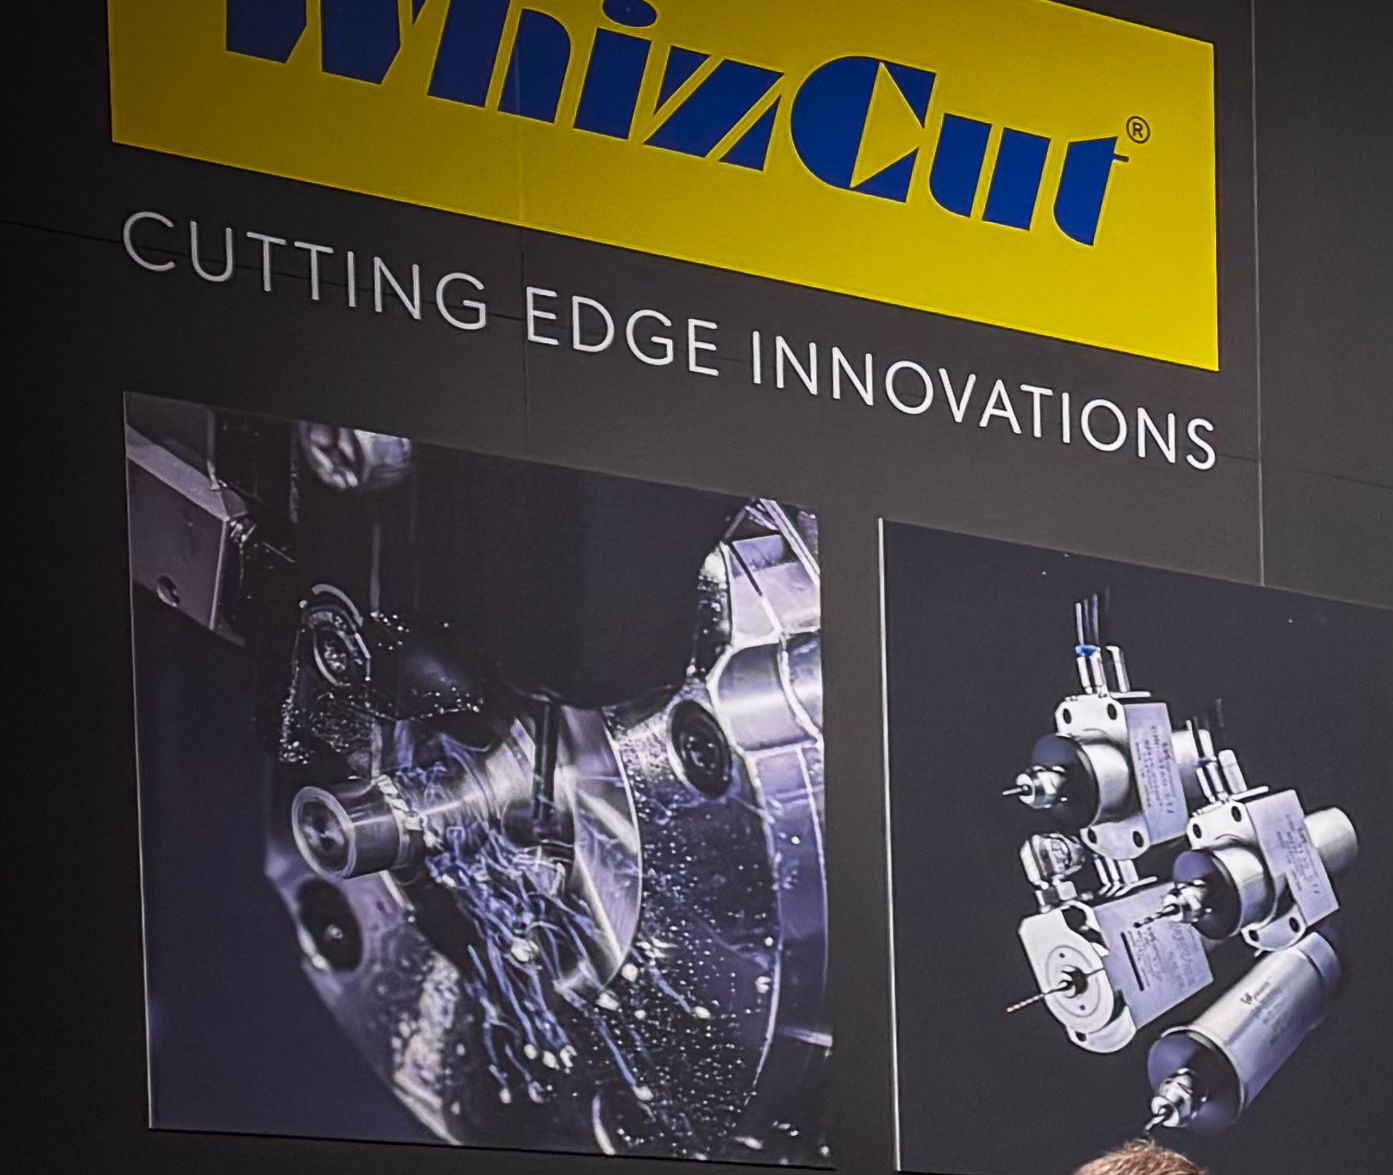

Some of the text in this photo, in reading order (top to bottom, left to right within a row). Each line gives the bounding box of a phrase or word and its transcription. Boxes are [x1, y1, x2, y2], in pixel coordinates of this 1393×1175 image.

[122, 210, 1217, 470] CUTTING EDGE INNOVATIONS
